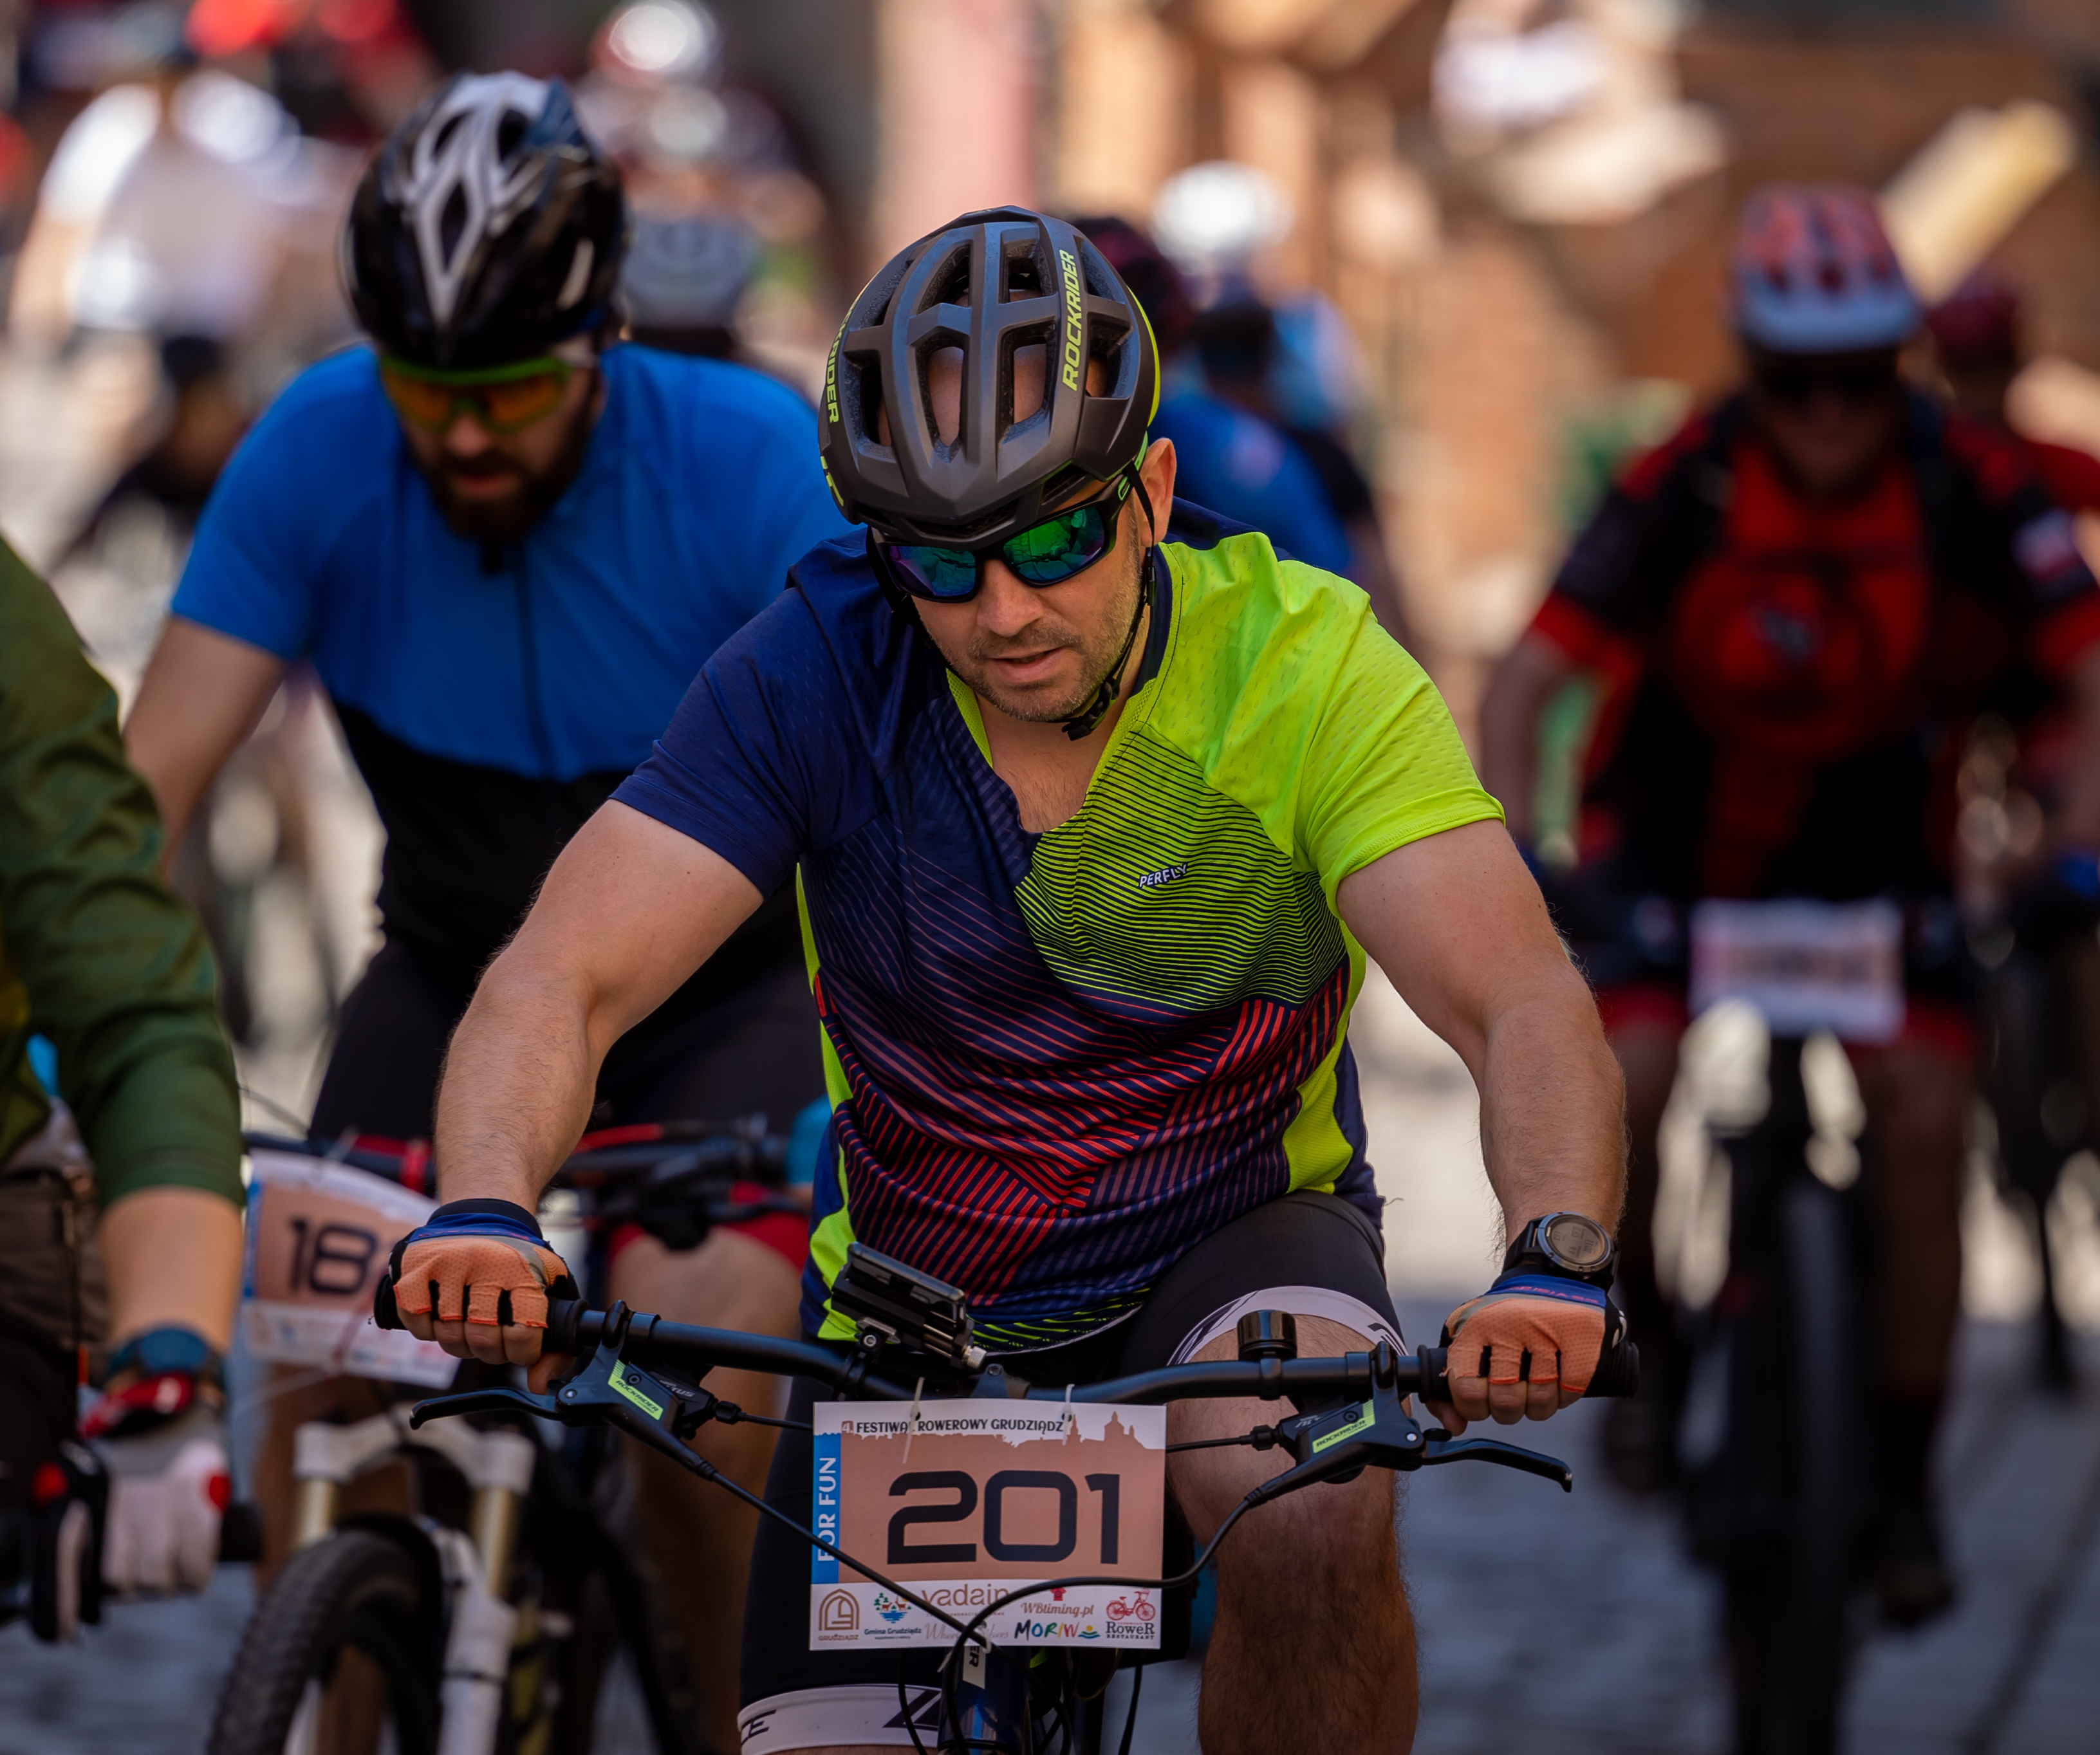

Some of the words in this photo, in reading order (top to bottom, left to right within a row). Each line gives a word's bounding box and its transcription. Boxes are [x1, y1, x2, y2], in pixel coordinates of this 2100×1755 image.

[1059, 249, 1082, 391] ROCKRIDER
[1139, 864, 1187, 887] PERFLY
[615, 1380, 659, 1411] ROCKRIDER
[918, 1418, 988, 1432] ROWEROWY
[991, 1418, 1064, 1435] GRUDZIĄDZ
[819, 1458, 837, 1505] FUN
[887, 1470, 1120, 1565] 201
[1105, 1621, 1155, 1635] RoweR
